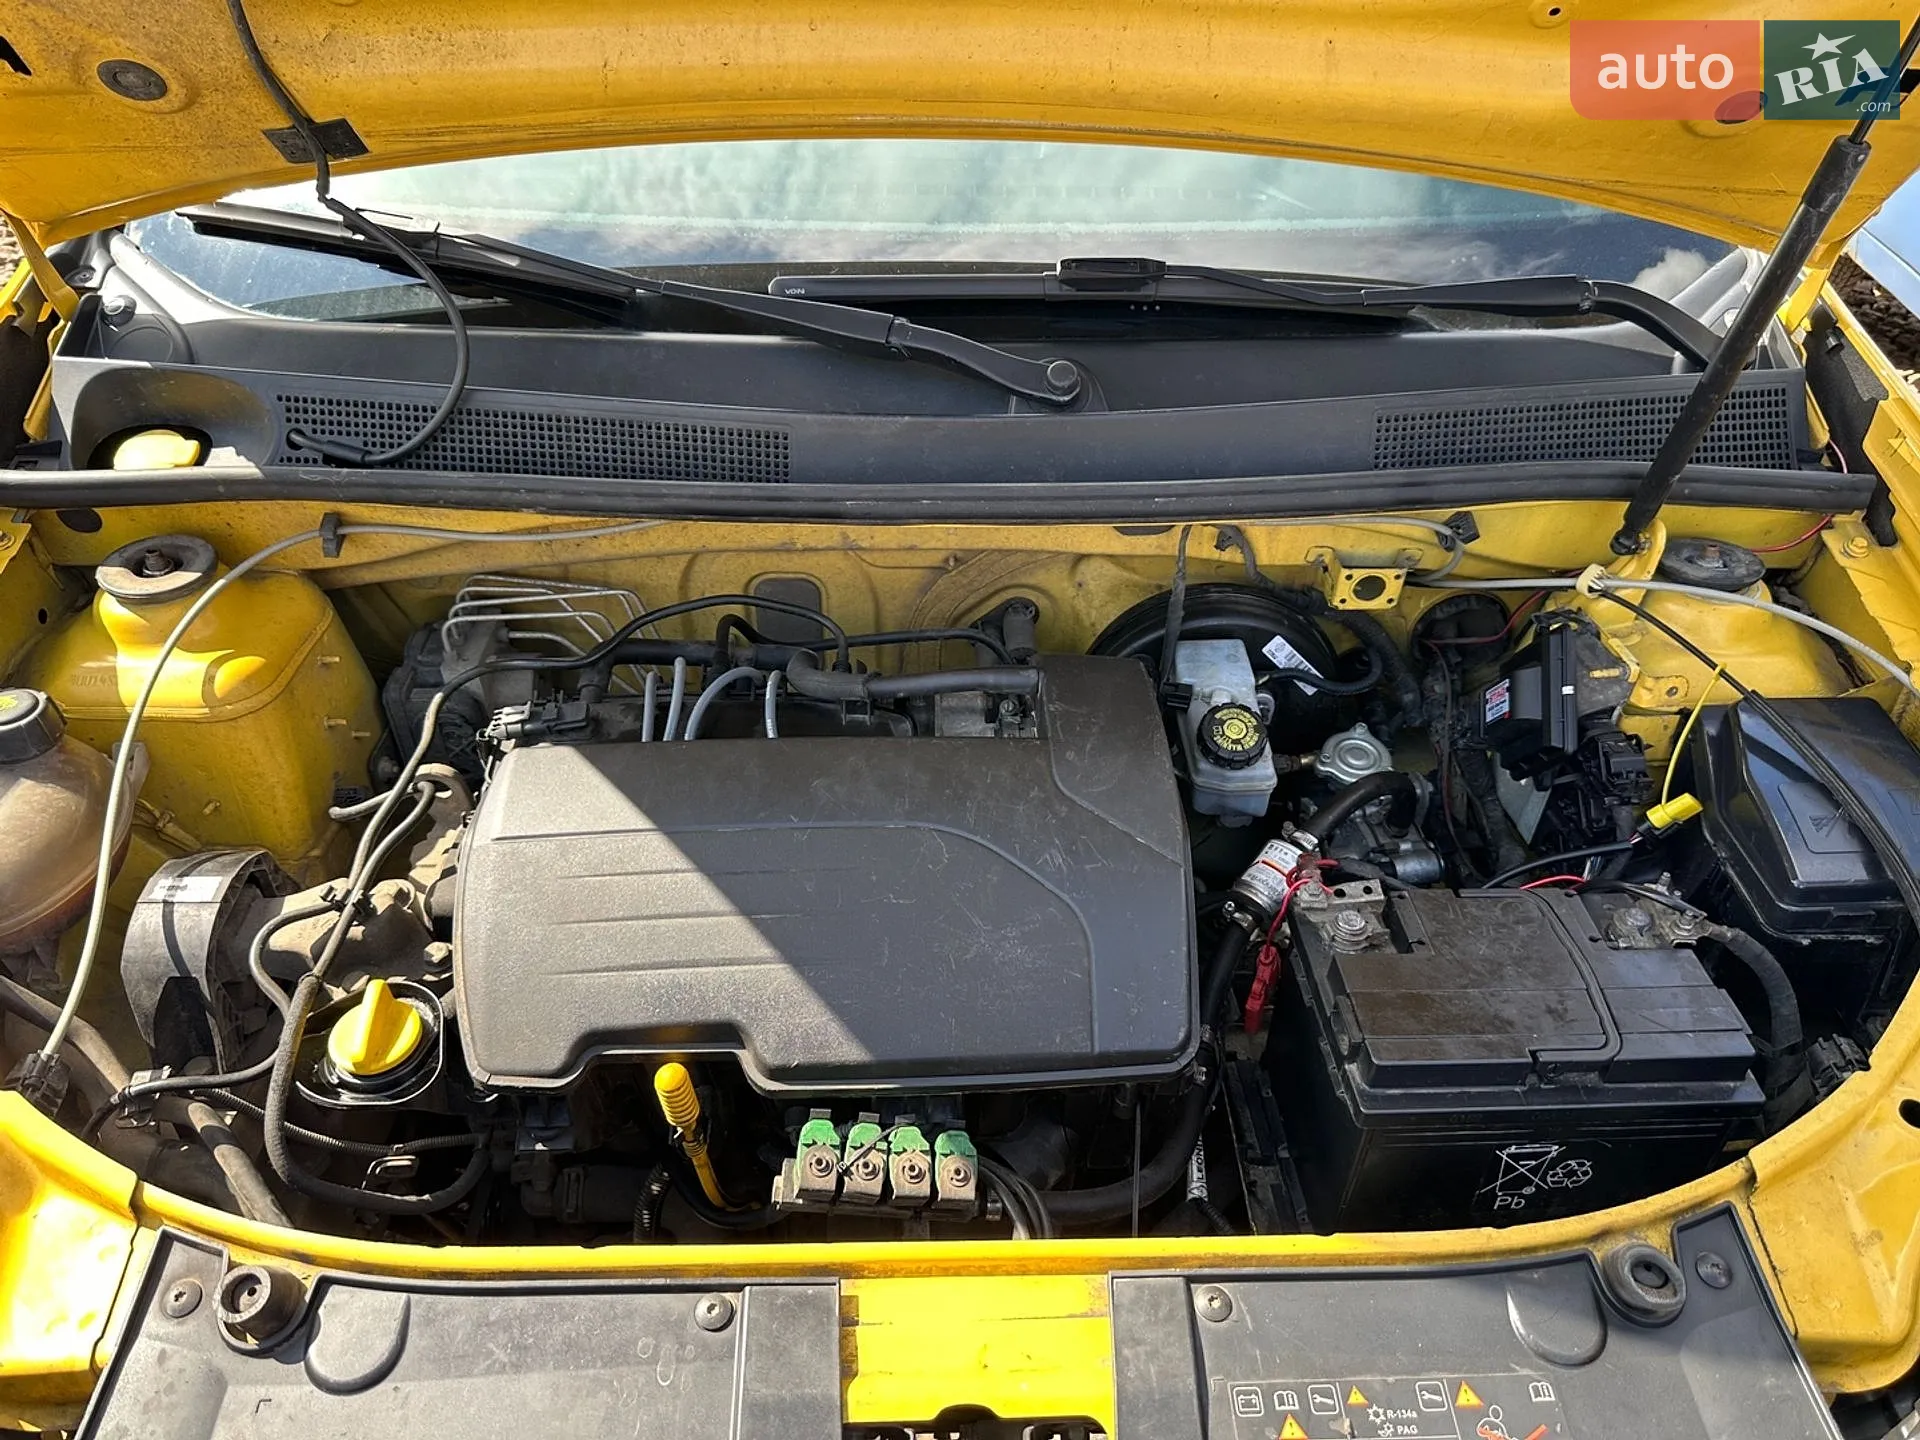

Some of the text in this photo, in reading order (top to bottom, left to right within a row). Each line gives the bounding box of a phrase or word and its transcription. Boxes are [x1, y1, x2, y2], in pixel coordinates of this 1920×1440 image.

[1493, 1196, 1526, 1209] Pb
[1386, 1408, 1418, 1419] R-134a
[1396, 1425, 1418, 1435] PAG
